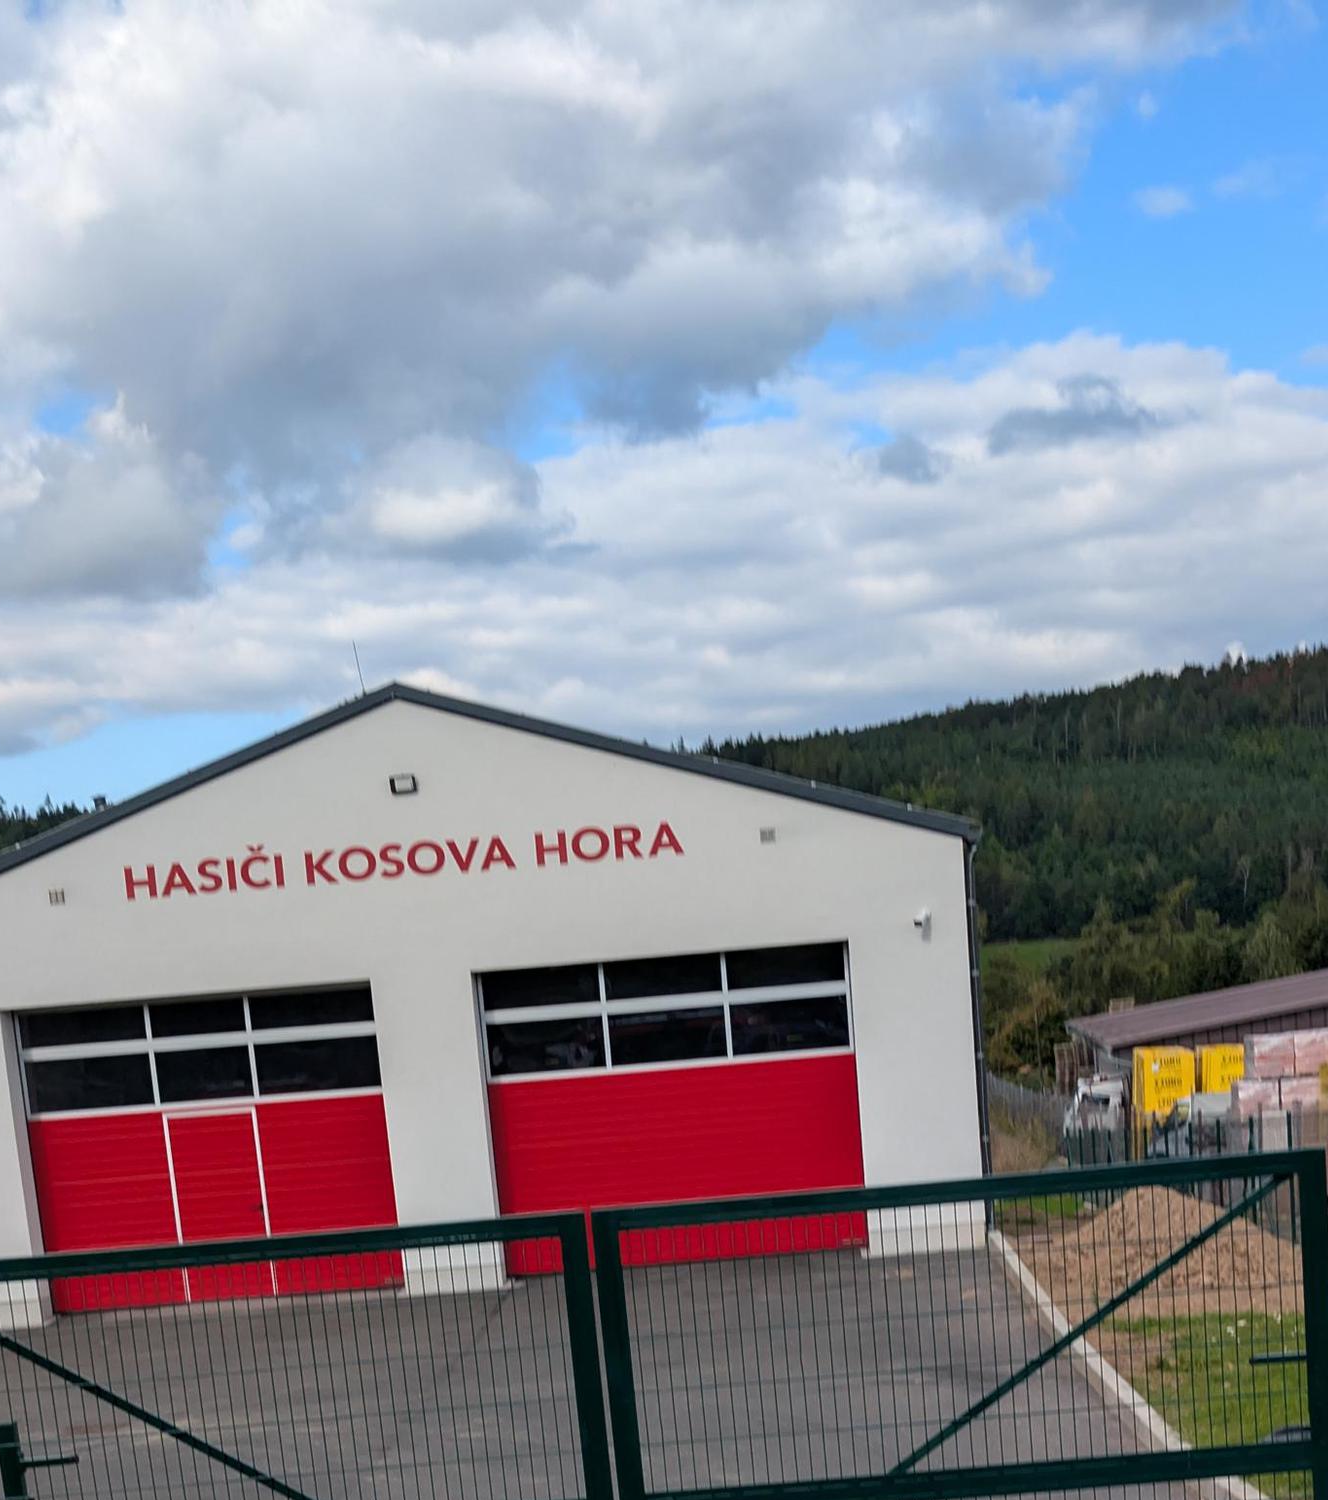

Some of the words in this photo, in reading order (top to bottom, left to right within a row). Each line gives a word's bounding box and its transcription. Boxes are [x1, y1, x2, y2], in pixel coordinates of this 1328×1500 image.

[123, 847, 286, 900] HASIČI
[304, 835, 517, 886] KOSOVA
[533, 820, 685, 866] HORA
